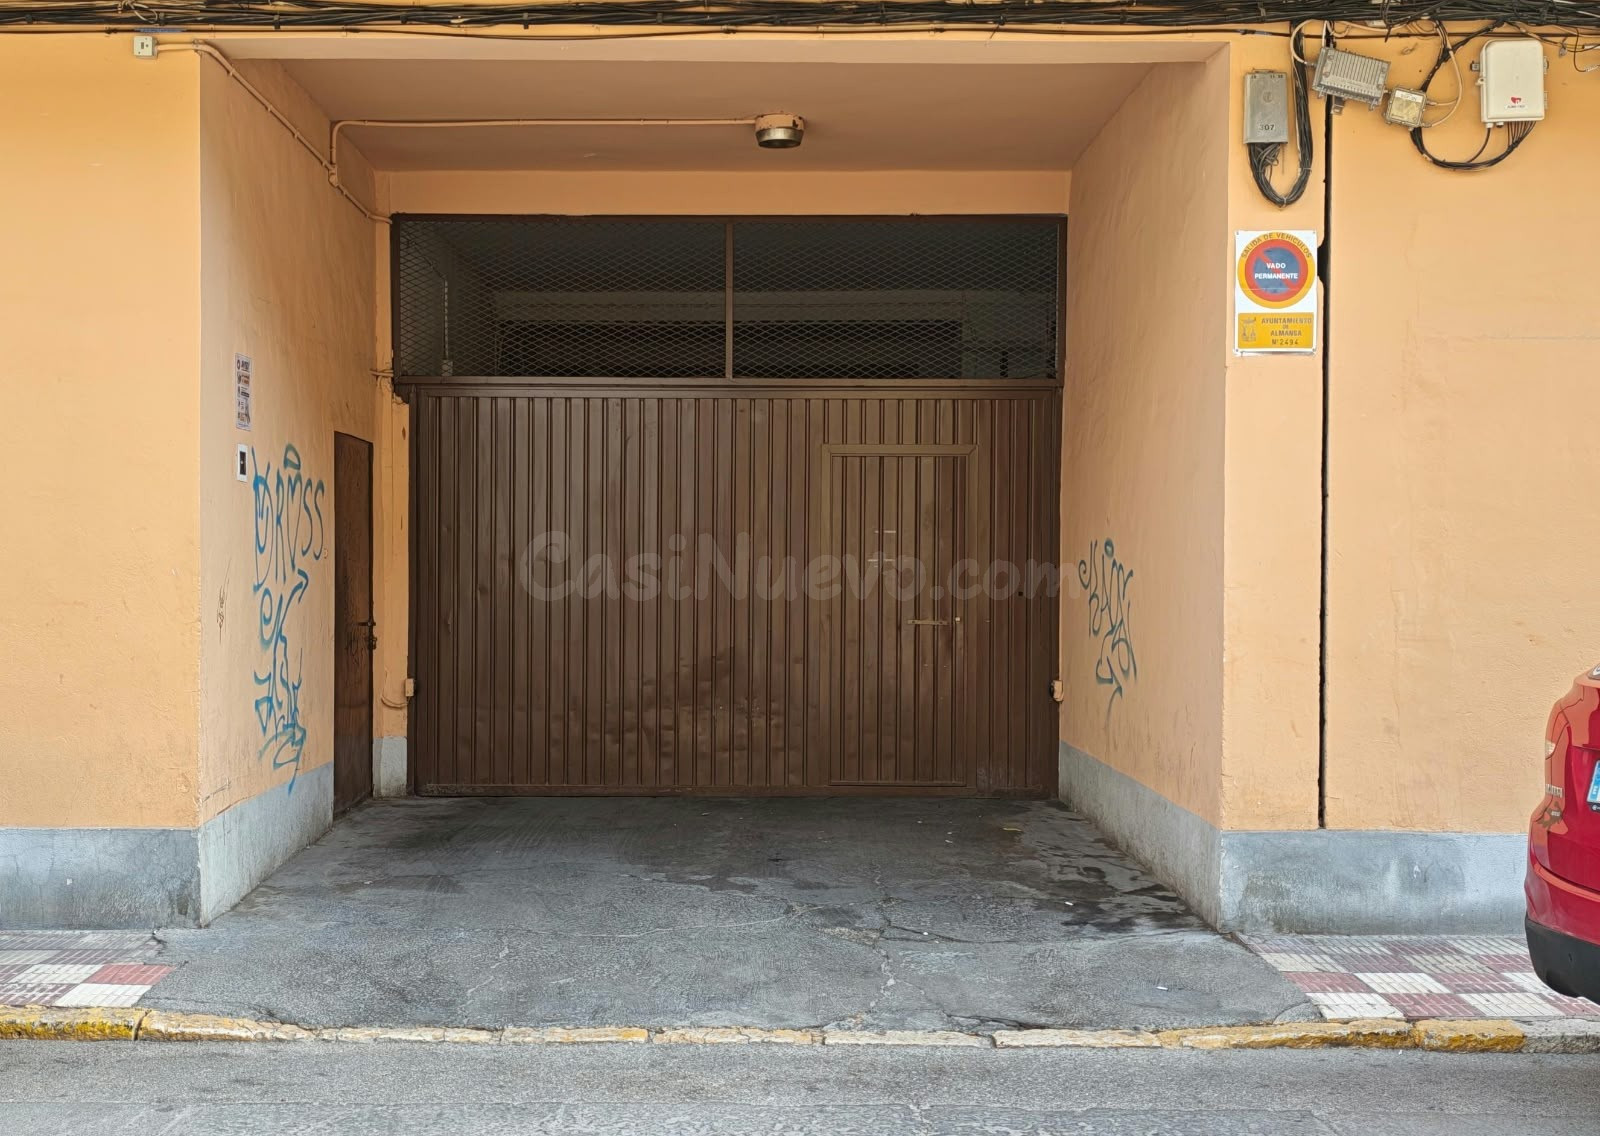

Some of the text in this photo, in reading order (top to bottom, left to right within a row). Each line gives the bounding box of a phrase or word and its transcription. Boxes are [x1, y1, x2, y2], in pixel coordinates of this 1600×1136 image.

[1241, 233, 1312, 258] SALIDA DE VEHICULOS
